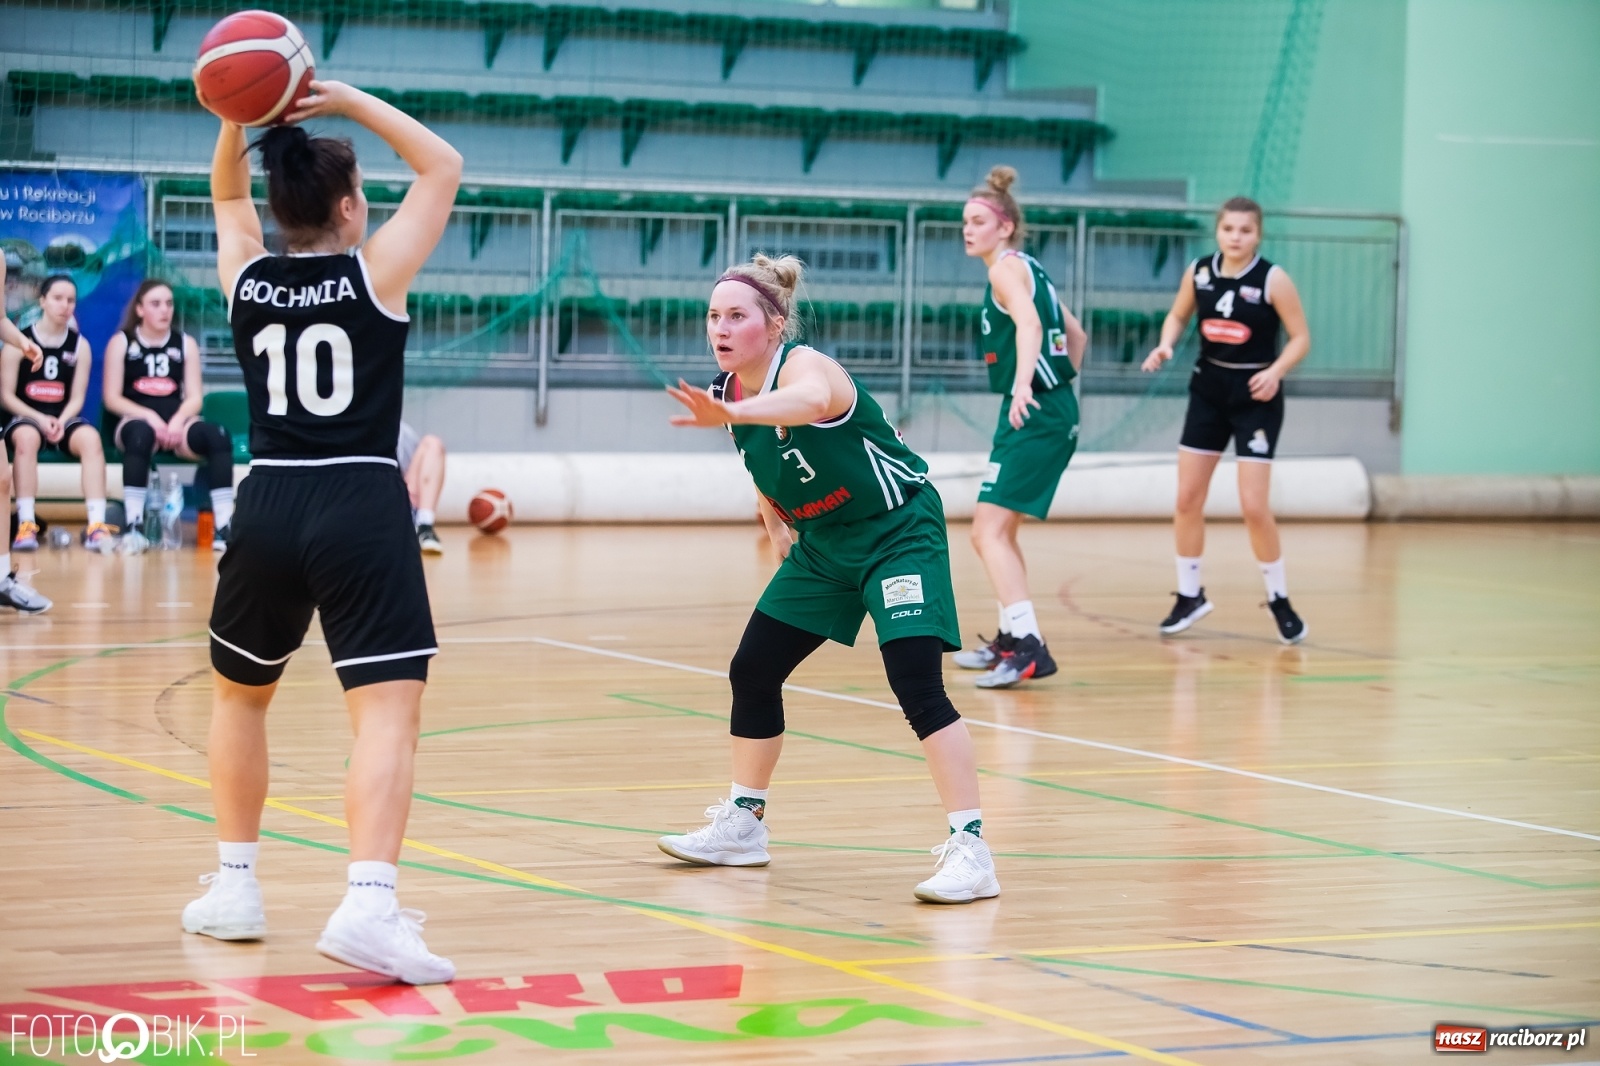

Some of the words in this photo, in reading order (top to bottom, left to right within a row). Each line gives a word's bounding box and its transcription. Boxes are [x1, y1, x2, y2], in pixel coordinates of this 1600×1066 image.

[23, 185, 97, 207] Rekreacji
[0, 208, 14, 220] w
[18, 205, 96, 225] Raciborzu
[239, 276, 357, 308] BOCHNIA
[1214, 290, 1236, 318] 4
[44, 355, 59, 380] 6
[144, 353, 170, 377] 13
[253, 323, 354, 417] 10
[781, 448, 816, 484] 3
